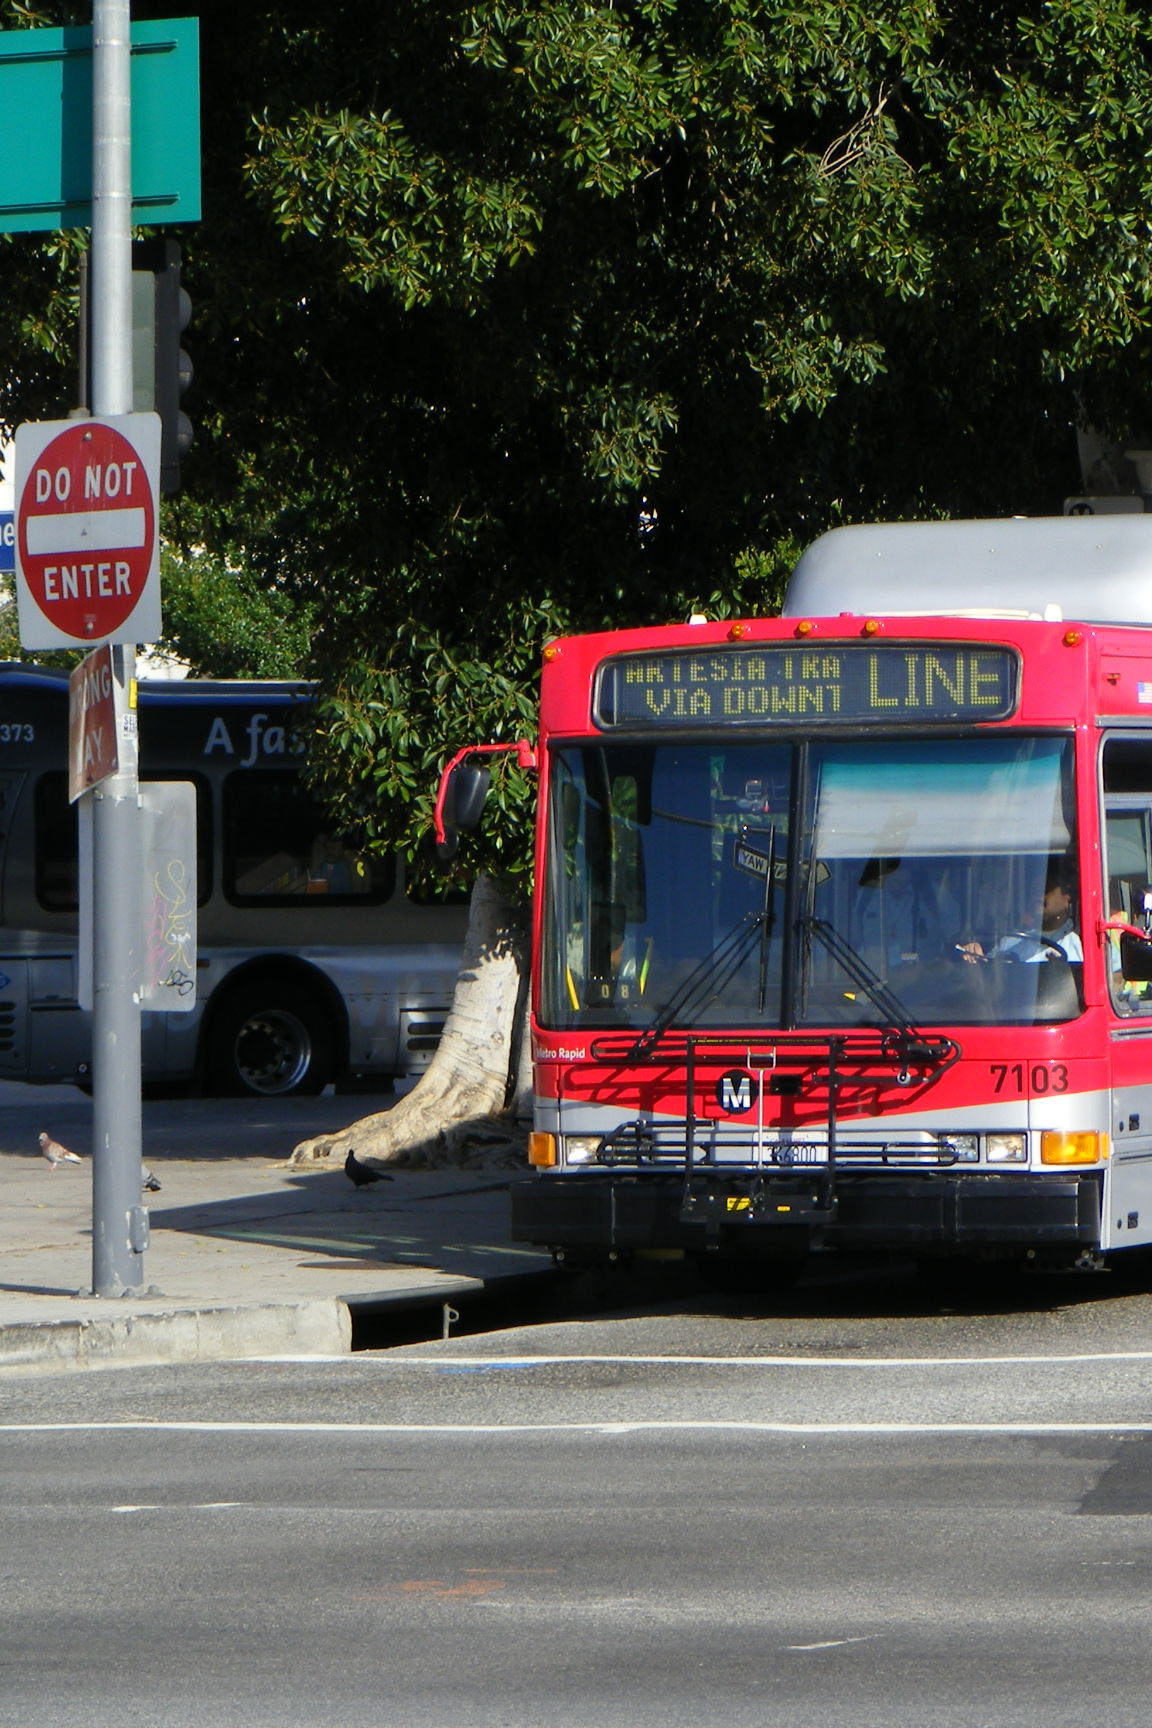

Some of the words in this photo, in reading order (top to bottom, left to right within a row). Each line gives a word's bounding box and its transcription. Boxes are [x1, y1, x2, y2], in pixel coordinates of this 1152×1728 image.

[36, 466, 71, 503] DO
[84, 461, 137, 499] NOT
[43, 561, 132, 601] ENTER
[869, 653, 1002, 708] LINE
[646, 688, 711, 716] VIA
[203, 717, 235, 755] A
[559, 1047, 586, 1061] Rapid
[989, 1064, 1068, 1093] 7103
